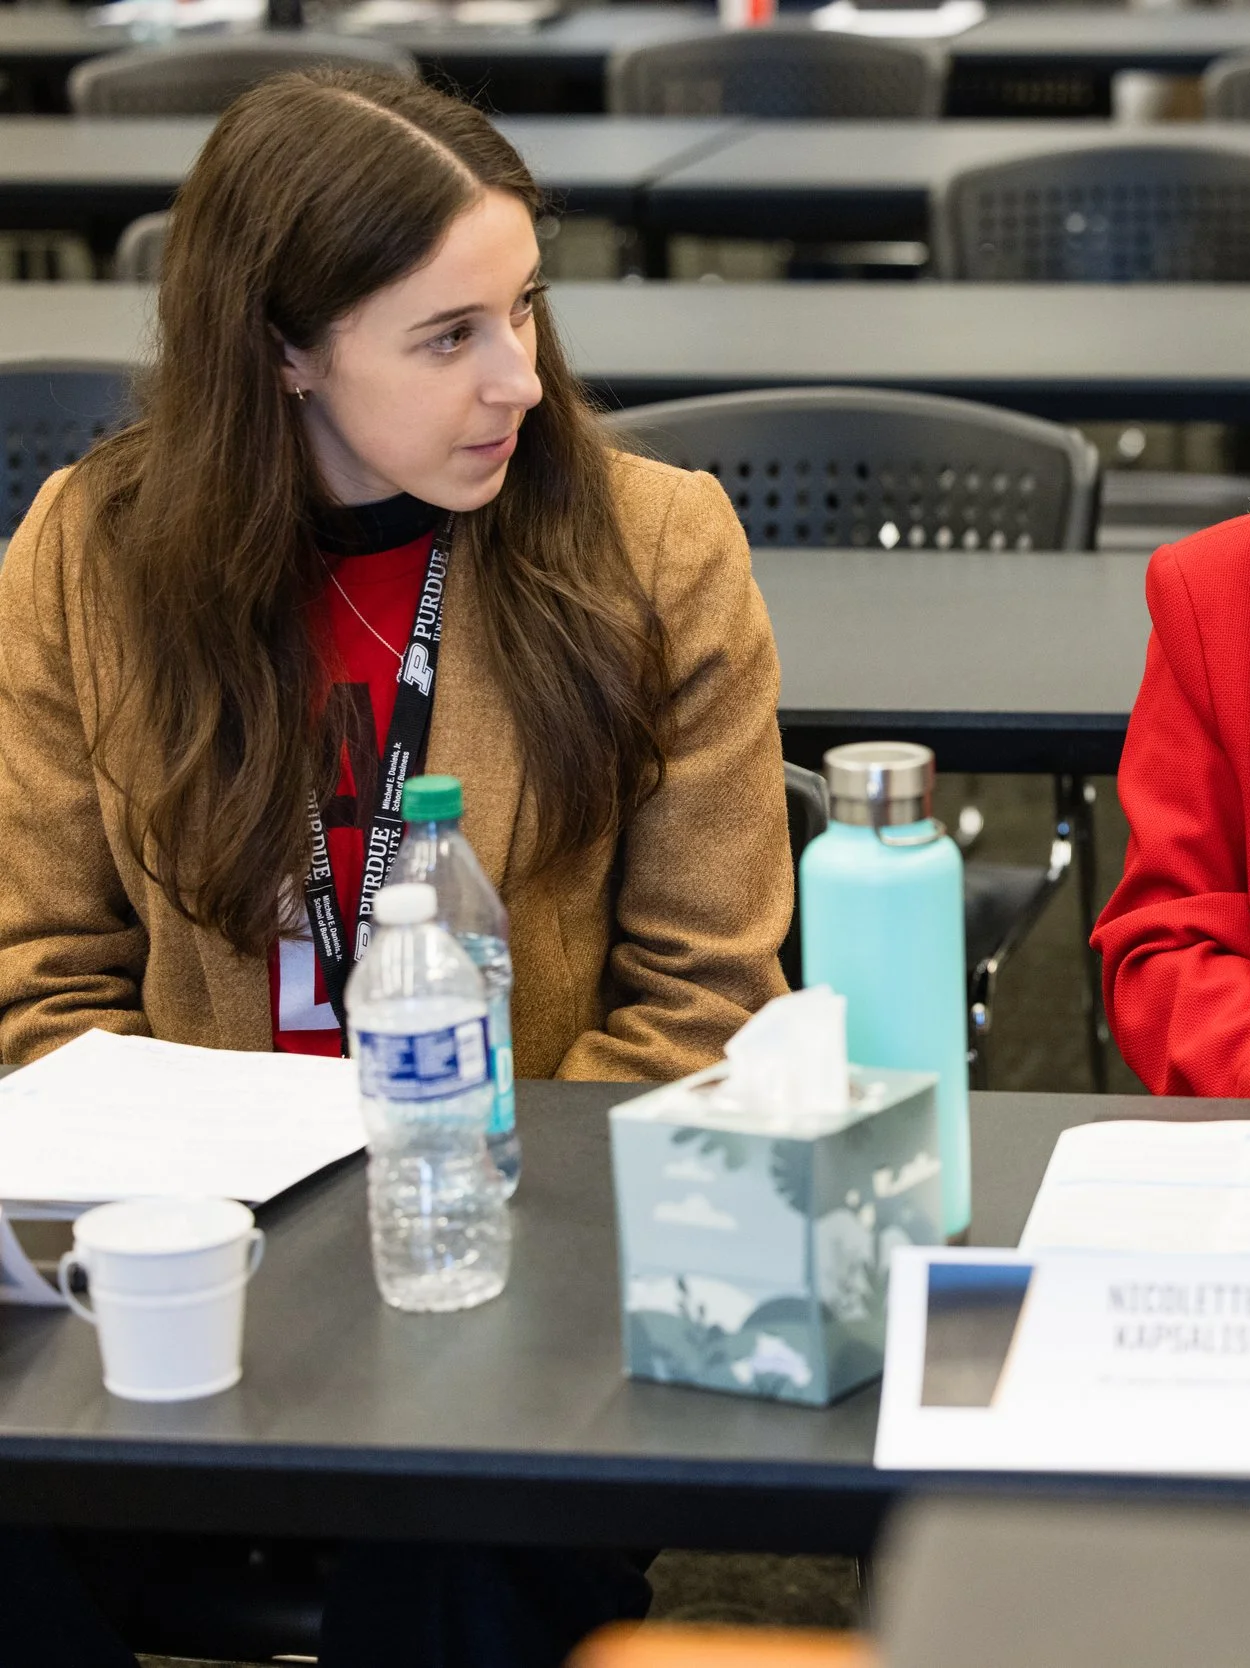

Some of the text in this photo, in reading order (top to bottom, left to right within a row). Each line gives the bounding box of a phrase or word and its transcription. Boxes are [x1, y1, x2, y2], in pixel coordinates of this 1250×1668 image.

[413, 548, 450, 640] PURDUE
[381, 784, 394, 810] Mitchell
[388, 750, 401, 776] Daniels,
[391, 751, 410, 812] School of Business
[359, 826, 391, 916] PURDUE
[313, 897, 325, 920] School
[320, 927, 333, 957] Business
[322, 894, 335, 920] Mitchell
